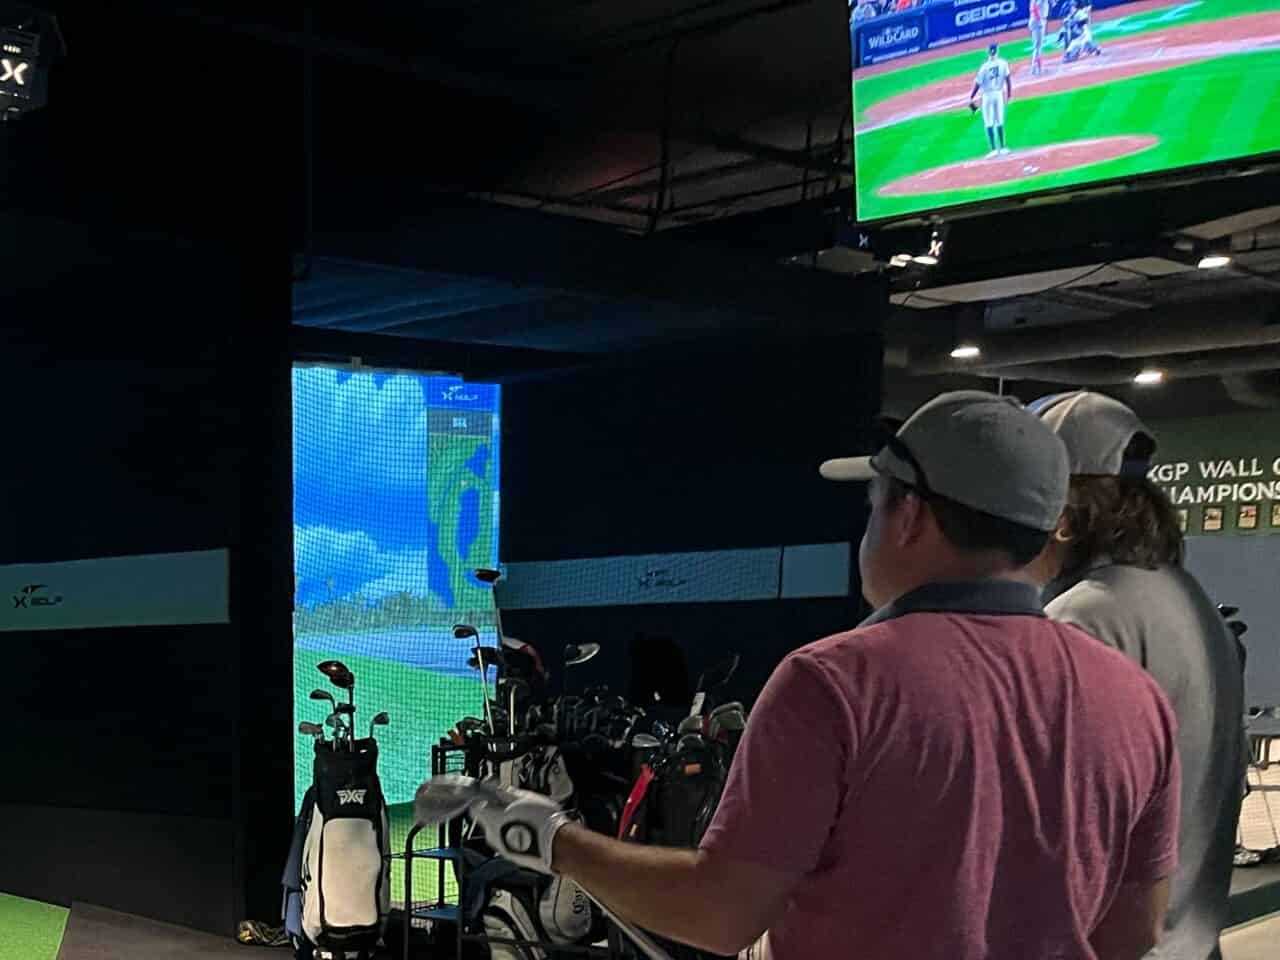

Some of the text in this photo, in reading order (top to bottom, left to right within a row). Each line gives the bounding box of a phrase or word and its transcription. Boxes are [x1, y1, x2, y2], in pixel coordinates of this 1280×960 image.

[955, 1, 1016, 27] GEICO
[1199, 458, 1264, 479] WALL
[1171, 480, 1280, 505] AMPION
[336, 789, 367, 805] PXG
